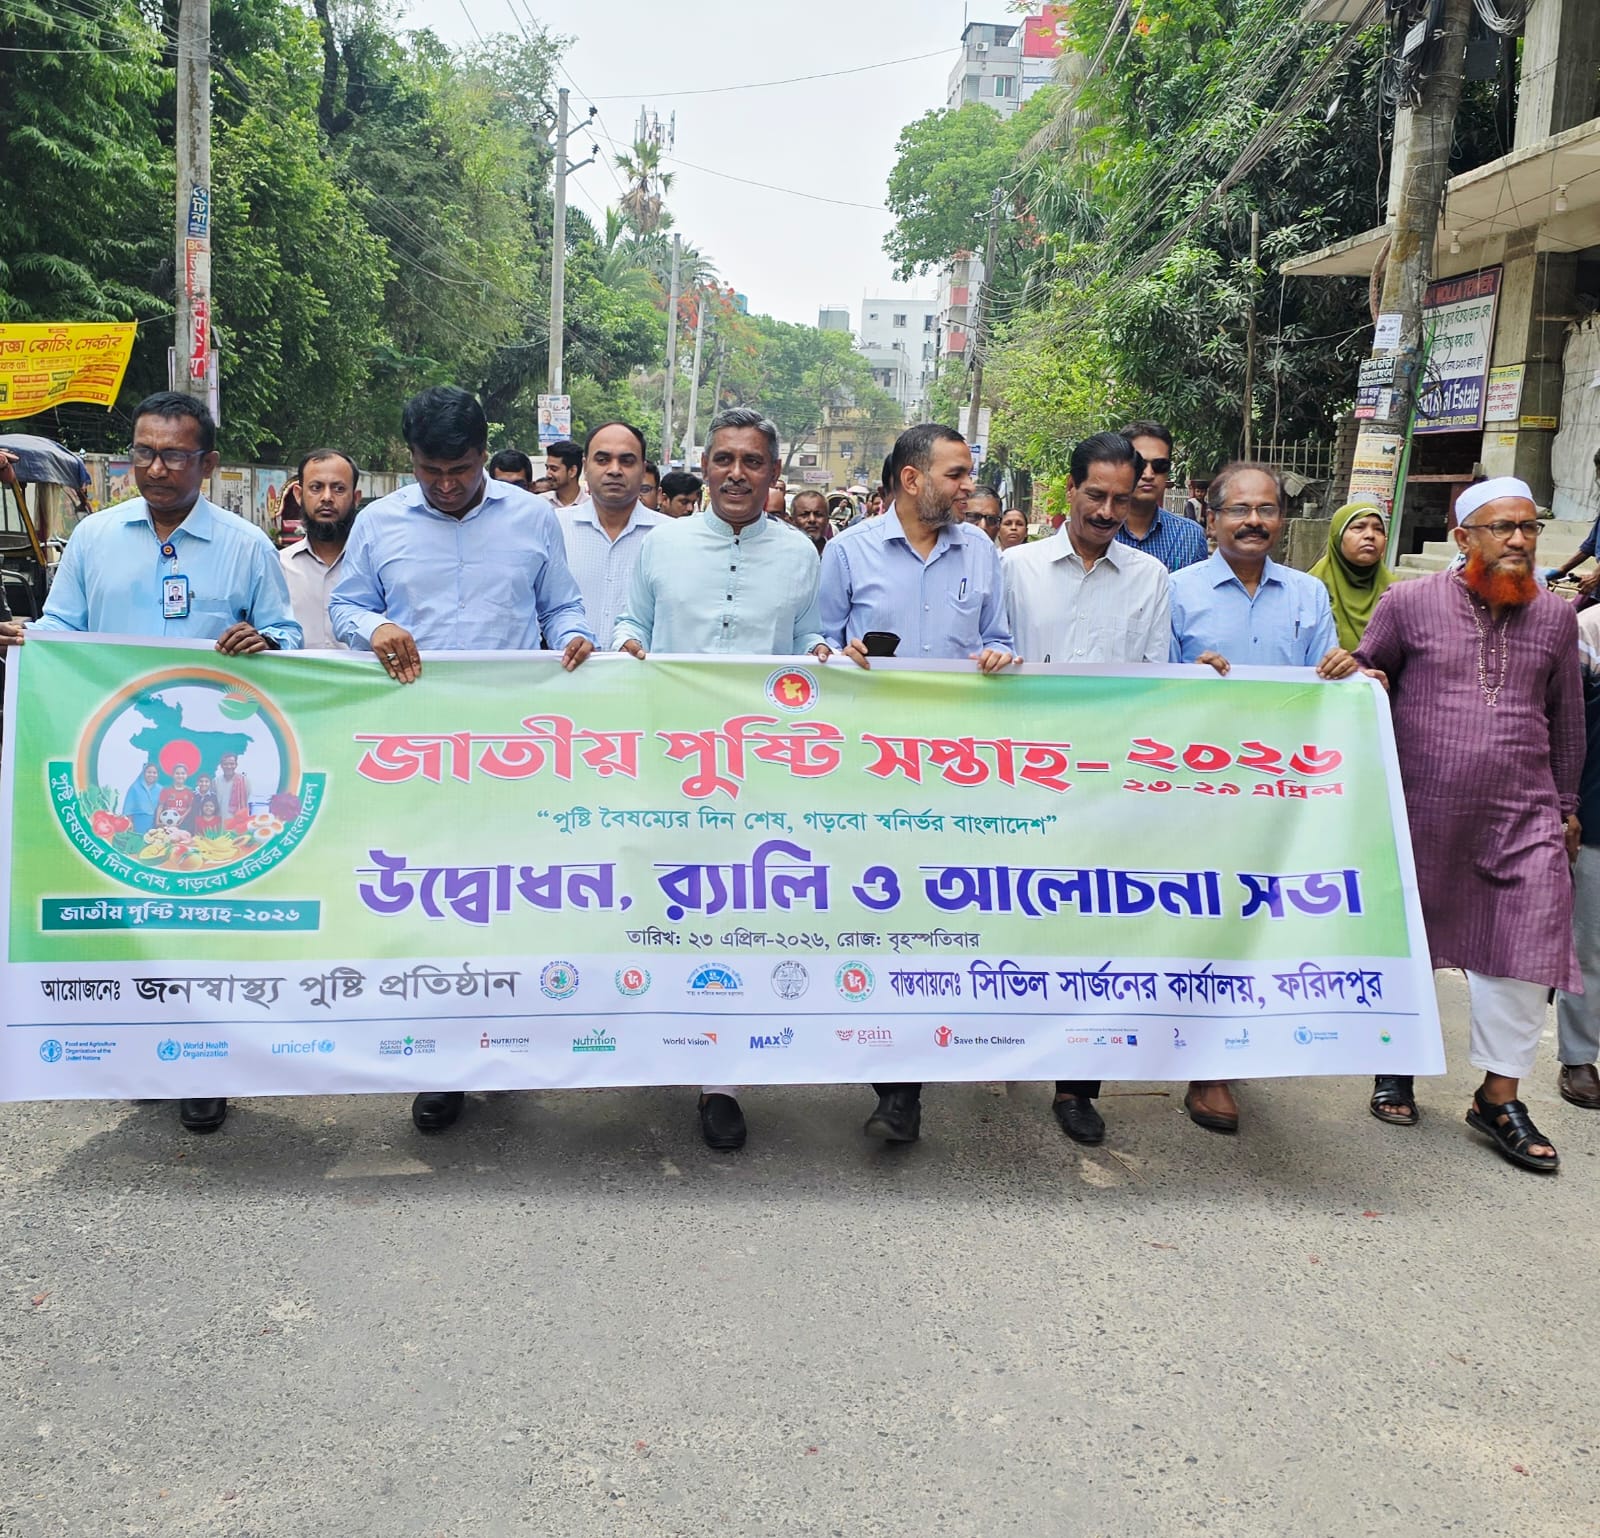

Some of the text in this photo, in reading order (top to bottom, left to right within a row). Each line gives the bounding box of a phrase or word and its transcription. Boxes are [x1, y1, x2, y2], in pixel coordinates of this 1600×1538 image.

[29, 333, 73, 353] কোচিং
[1452, 384, 1480, 410] Estate
[355, 714, 645, 783] জাতীয়
[656, 715, 846, 800] পুষ্টি
[1126, 737, 1344, 777] ২০২৬
[1121, 778, 1345, 800] ২৩-২৯ এপ্রিল
[599, 806, 692, 829] বৈষম্যের
[698, 806, 735, 832] দিন
[744, 810, 794, 834] শেষ,
[803, 809, 867, 835] গড়বো
[874, 808, 946, 834] স্বনির্ভর
[51, 771, 320, 892] পুষ্টি বৈষম্যের দিন শেষ, গড়বো স্বনির্ভর বাংলাদেশ
[355, 849, 633, 924] উদ্বোধন,
[852, 865, 901, 911] ও
[918, 865, 1221, 917] আলোচনা
[1236, 868, 1361, 918] সভা
[59, 901, 301, 925] জাতীয় পুষ্টি সপ্তাহ-২০২৬
[625, 926, 981, 954] তারিখ: ২৩ এপ্রিল-২০২৬, রোজ: বৃহস্পতিবার
[40, 977, 121, 1002] আয়োজনেঃ
[131, 974, 287, 1010] জনস্বাস্থ্য
[300, 966, 367, 1010] পুষ্টি
[379, 961, 523, 1002] প্রতিষ্ঠান
[966, 958, 1050, 1002] সিভিল
[1055, 960, 1160, 1002] সার্জনের
[1164, 962, 1267, 1009] কার্যালয়,
[1271, 961, 1383, 1008] ফরিদপুর
[183, 1041, 229, 1050] World Health
[491, 1037, 530, 1045] NUTRITION
[572, 1036, 617, 1046] Nutrition
[662, 1037, 710, 1046] World Vision
[750, 1035, 779, 1049] MAX
[857, 1026, 892, 1044] gain
[953, 1036, 1026, 1045] Save the Children
[182, 1050, 229, 1059] Organization
[271, 1039, 317, 1054] unicef
